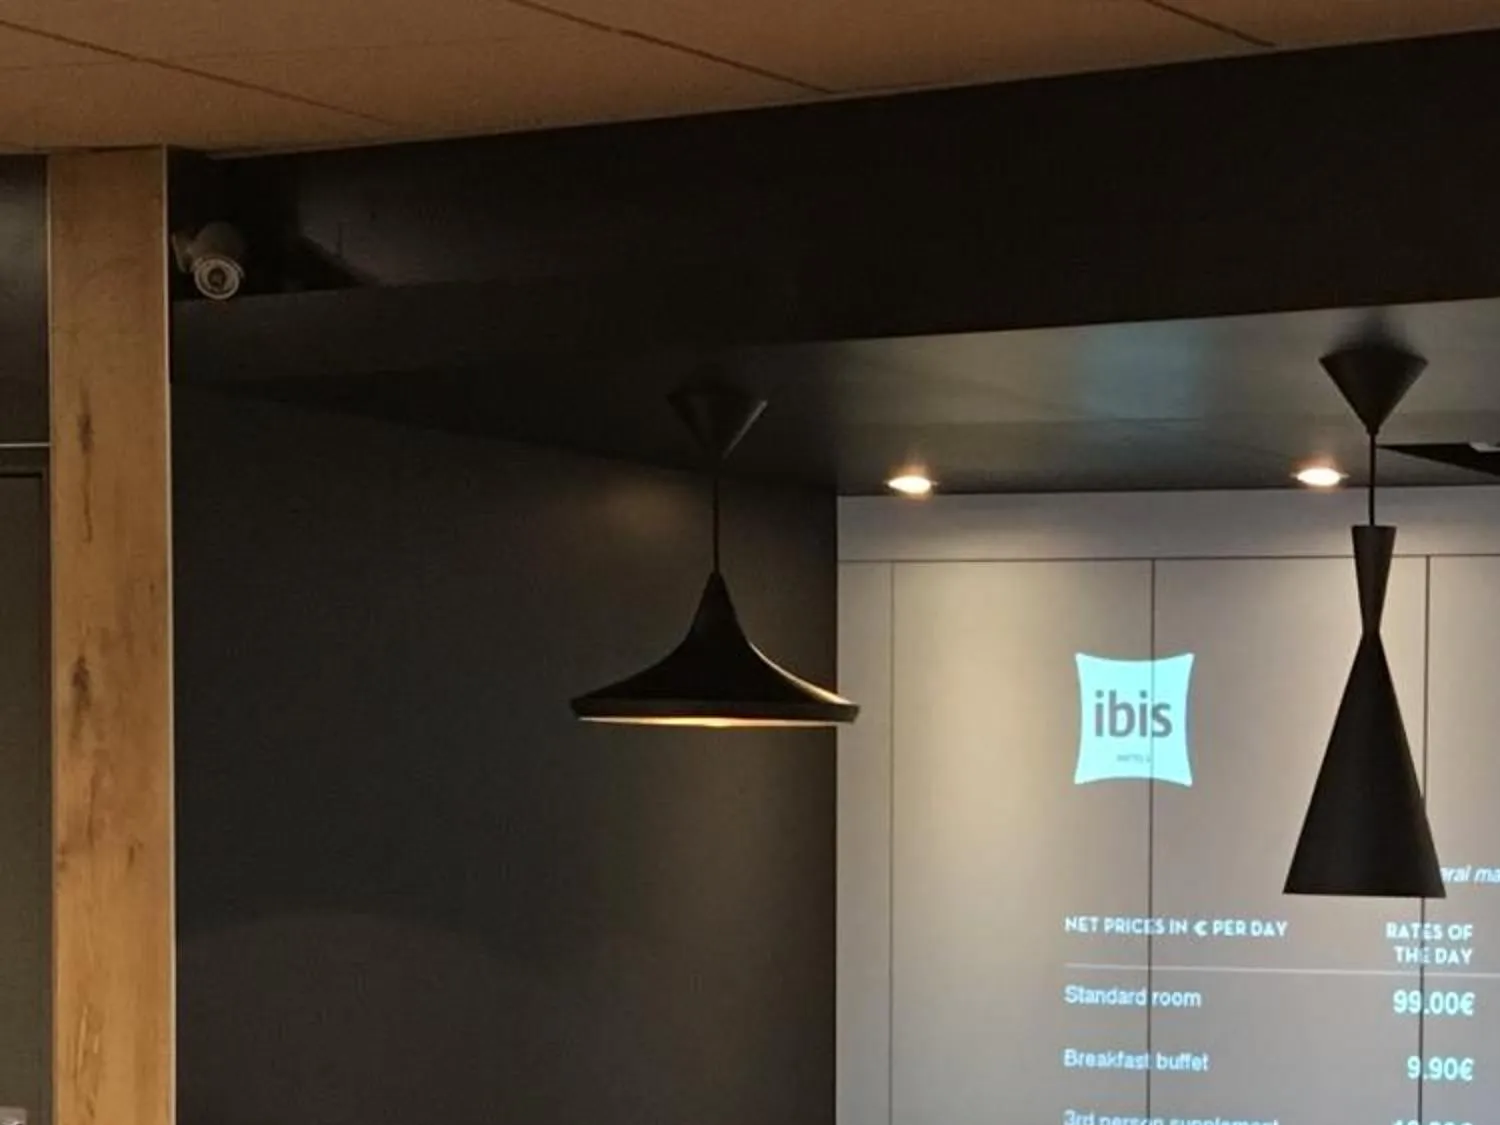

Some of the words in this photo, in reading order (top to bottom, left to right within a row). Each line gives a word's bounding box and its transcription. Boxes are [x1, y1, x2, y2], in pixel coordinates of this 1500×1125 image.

[1094, 689, 1173, 738] ibis
[1064, 916, 1100, 933] NET
[1103, 917, 1165, 936] PRICES
[1169, 919, 1187, 935] IN
[1213, 920, 1247, 937] PER
[1250, 921, 1288, 938] DAY
[1386, 922, 1443, 941] RATES
[1448, 924, 1473, 942] OF
[1435, 947, 1473, 966] DAY
[1064, 984, 1148, 1006] Standard
[1151, 991, 1203, 1008] room
[1393, 990, 1476, 1017] 99.00€
[1063, 1048, 1150, 1070] Breakfast
[1155, 1052, 1210, 1072] buffet
[1407, 1055, 1475, 1082] 9.90€
